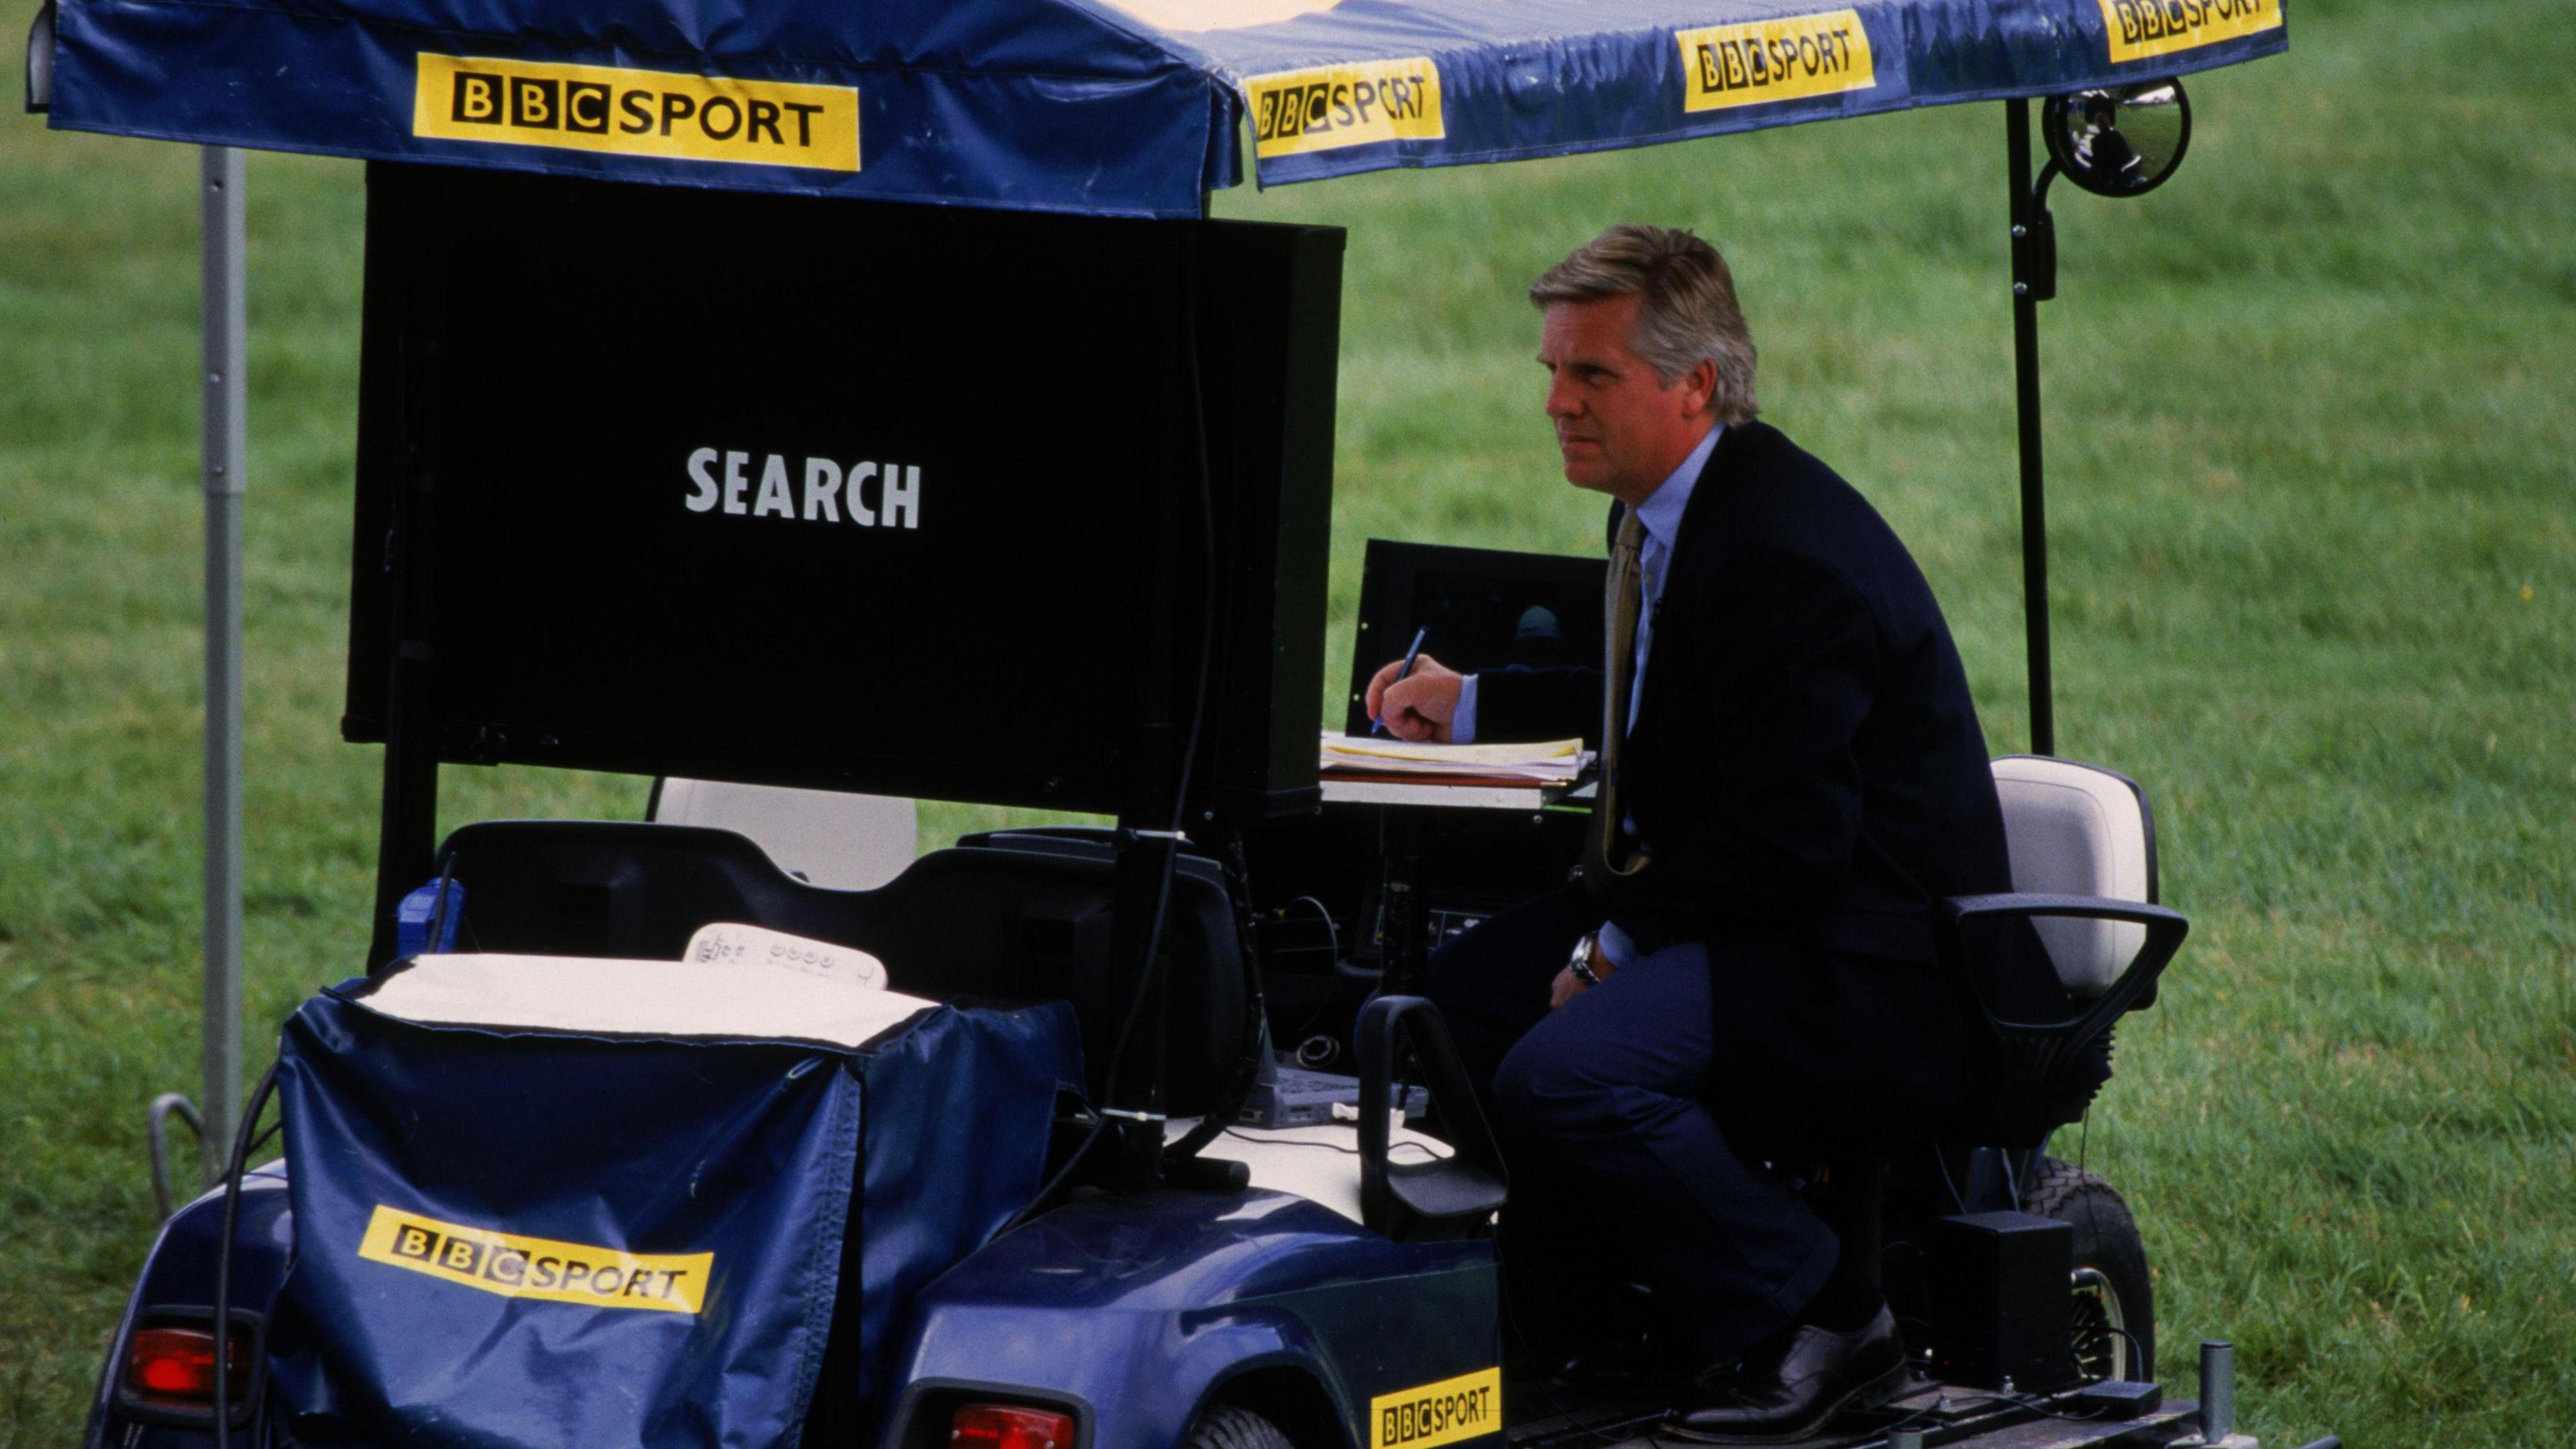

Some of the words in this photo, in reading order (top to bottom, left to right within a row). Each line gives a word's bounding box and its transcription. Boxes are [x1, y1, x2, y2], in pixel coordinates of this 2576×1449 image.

[2116, 0, 2187, 45] BBC
[1697, 39, 1769, 93] BBC
[1768, 30, 1849, 82] SPORT
[451, 71, 611, 134] BBC
[619, 91, 824, 147] SPORT
[1257, 83, 1332, 142] BBC
[685, 447, 920, 529] SEARCH
[391, 1224, 531, 1287] BBC
[530, 1256, 687, 1299] SPORT
[1383, 1397, 1432, 1447] BBC
[1434, 1386, 1489, 1432] SPORT
